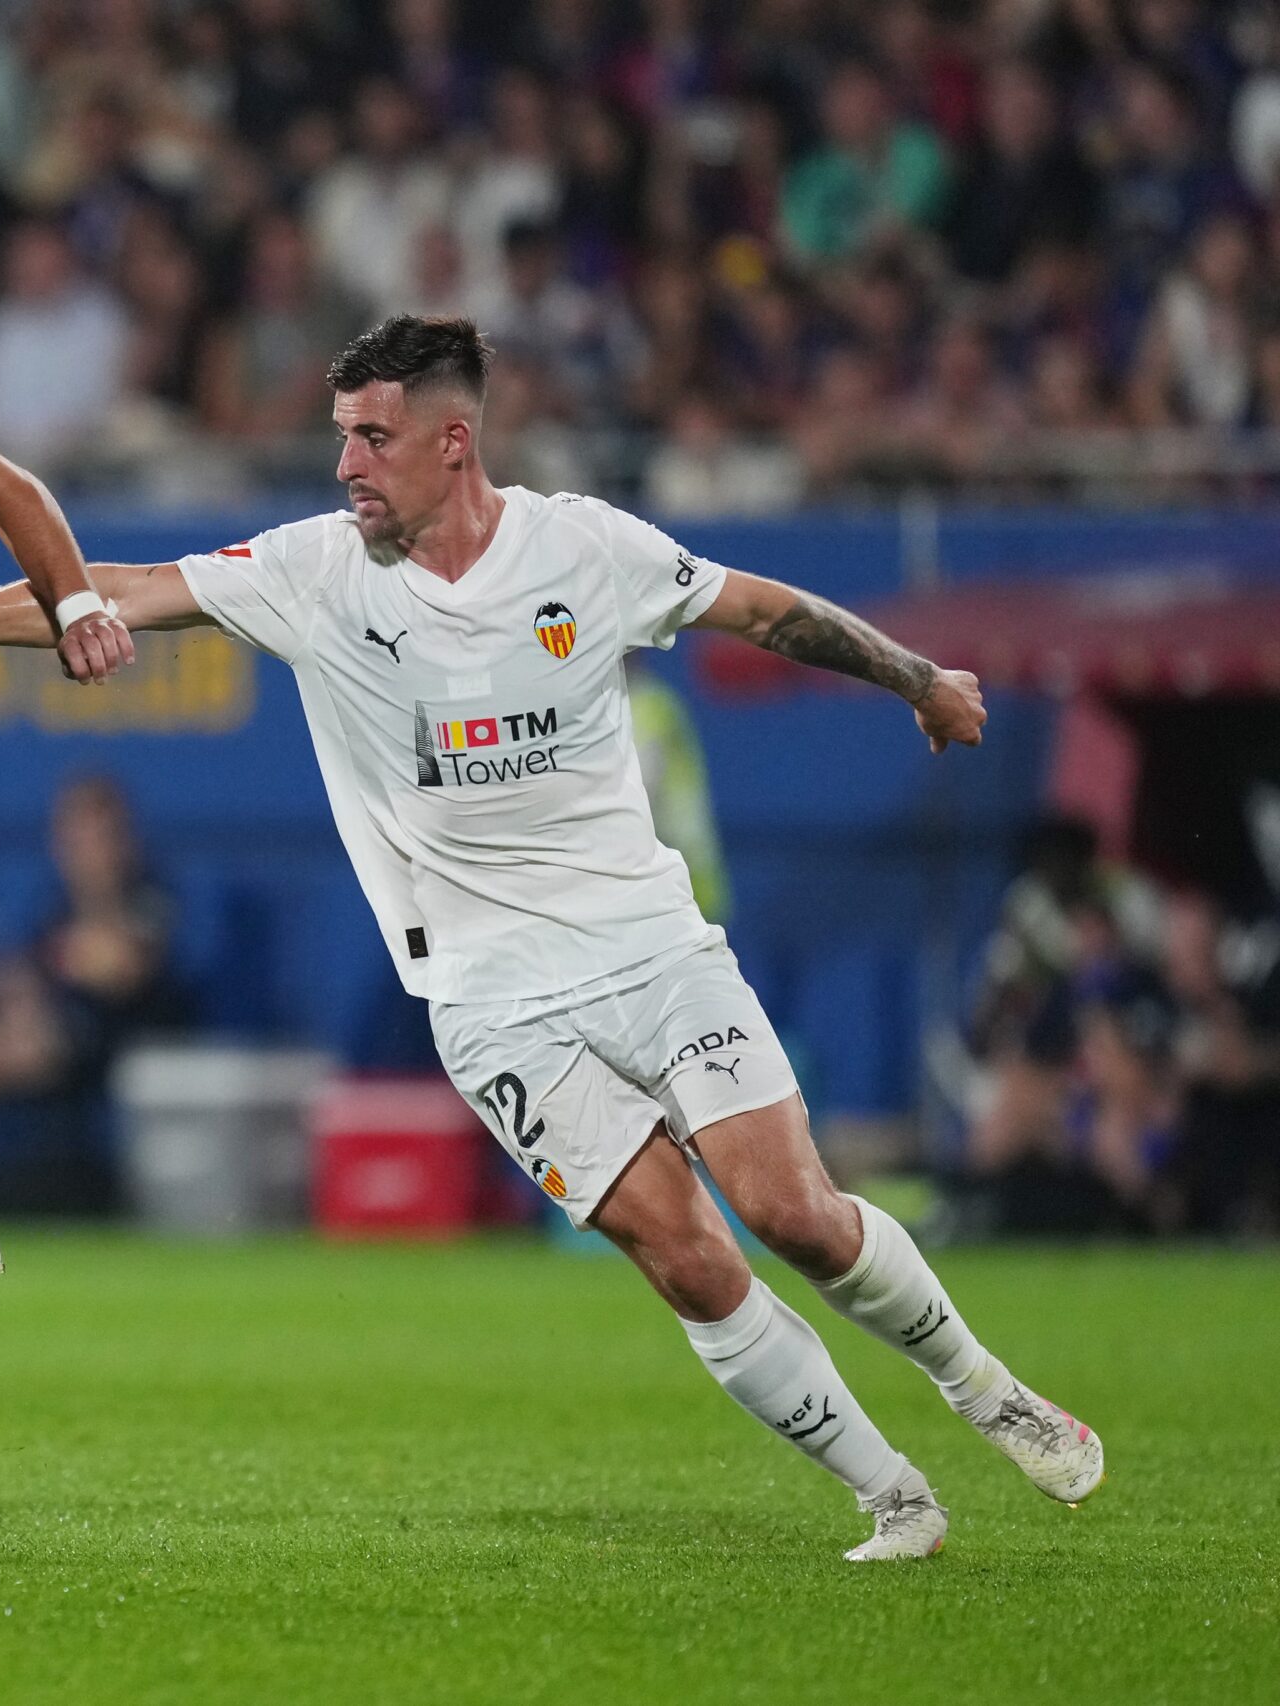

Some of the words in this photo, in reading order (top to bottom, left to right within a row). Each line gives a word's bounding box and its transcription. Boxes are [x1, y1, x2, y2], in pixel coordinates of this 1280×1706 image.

[502, 707, 558, 742] TM
[441, 744, 560, 787] Tower
[659, 1026, 750, 1079] ODA
[776, 1393, 813, 1430] VCF
